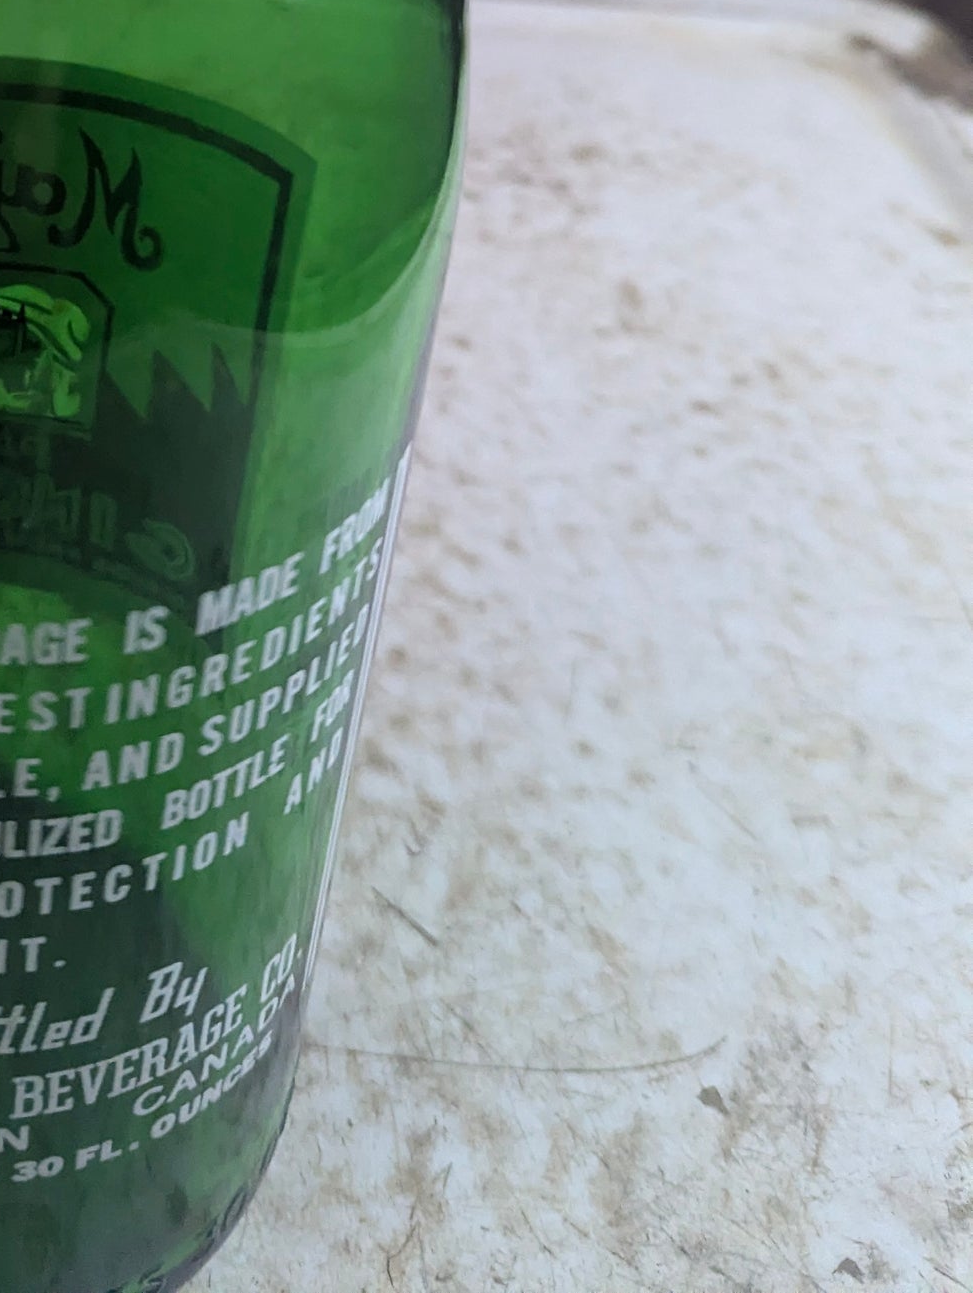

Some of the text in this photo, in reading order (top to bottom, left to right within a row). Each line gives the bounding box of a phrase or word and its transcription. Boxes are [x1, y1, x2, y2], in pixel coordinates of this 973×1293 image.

[104, 536, 383, 725] INGREDIENTS
[124, 606, 171, 654] IS
[196, 552, 305, 636] MADE
[319, 477, 390, 574] FROM
[82, 732, 185, 791] AND
[161, 733, 291, 830] BOTTLE
[310, 668, 355, 743] FOR
[284, 727, 343, 815] AND
[9, 983, 247, 1119] BEVERAGE
[260, 933, 302, 1004] CO.
[132, 973, 295, 1116] CANADA
[139, 962, 208, 1024] By
[10, 1156, 64, 1182] 30
[75, 1139, 140, 1170] FL.
[150, 1029, 273, 1139] OUNCES
